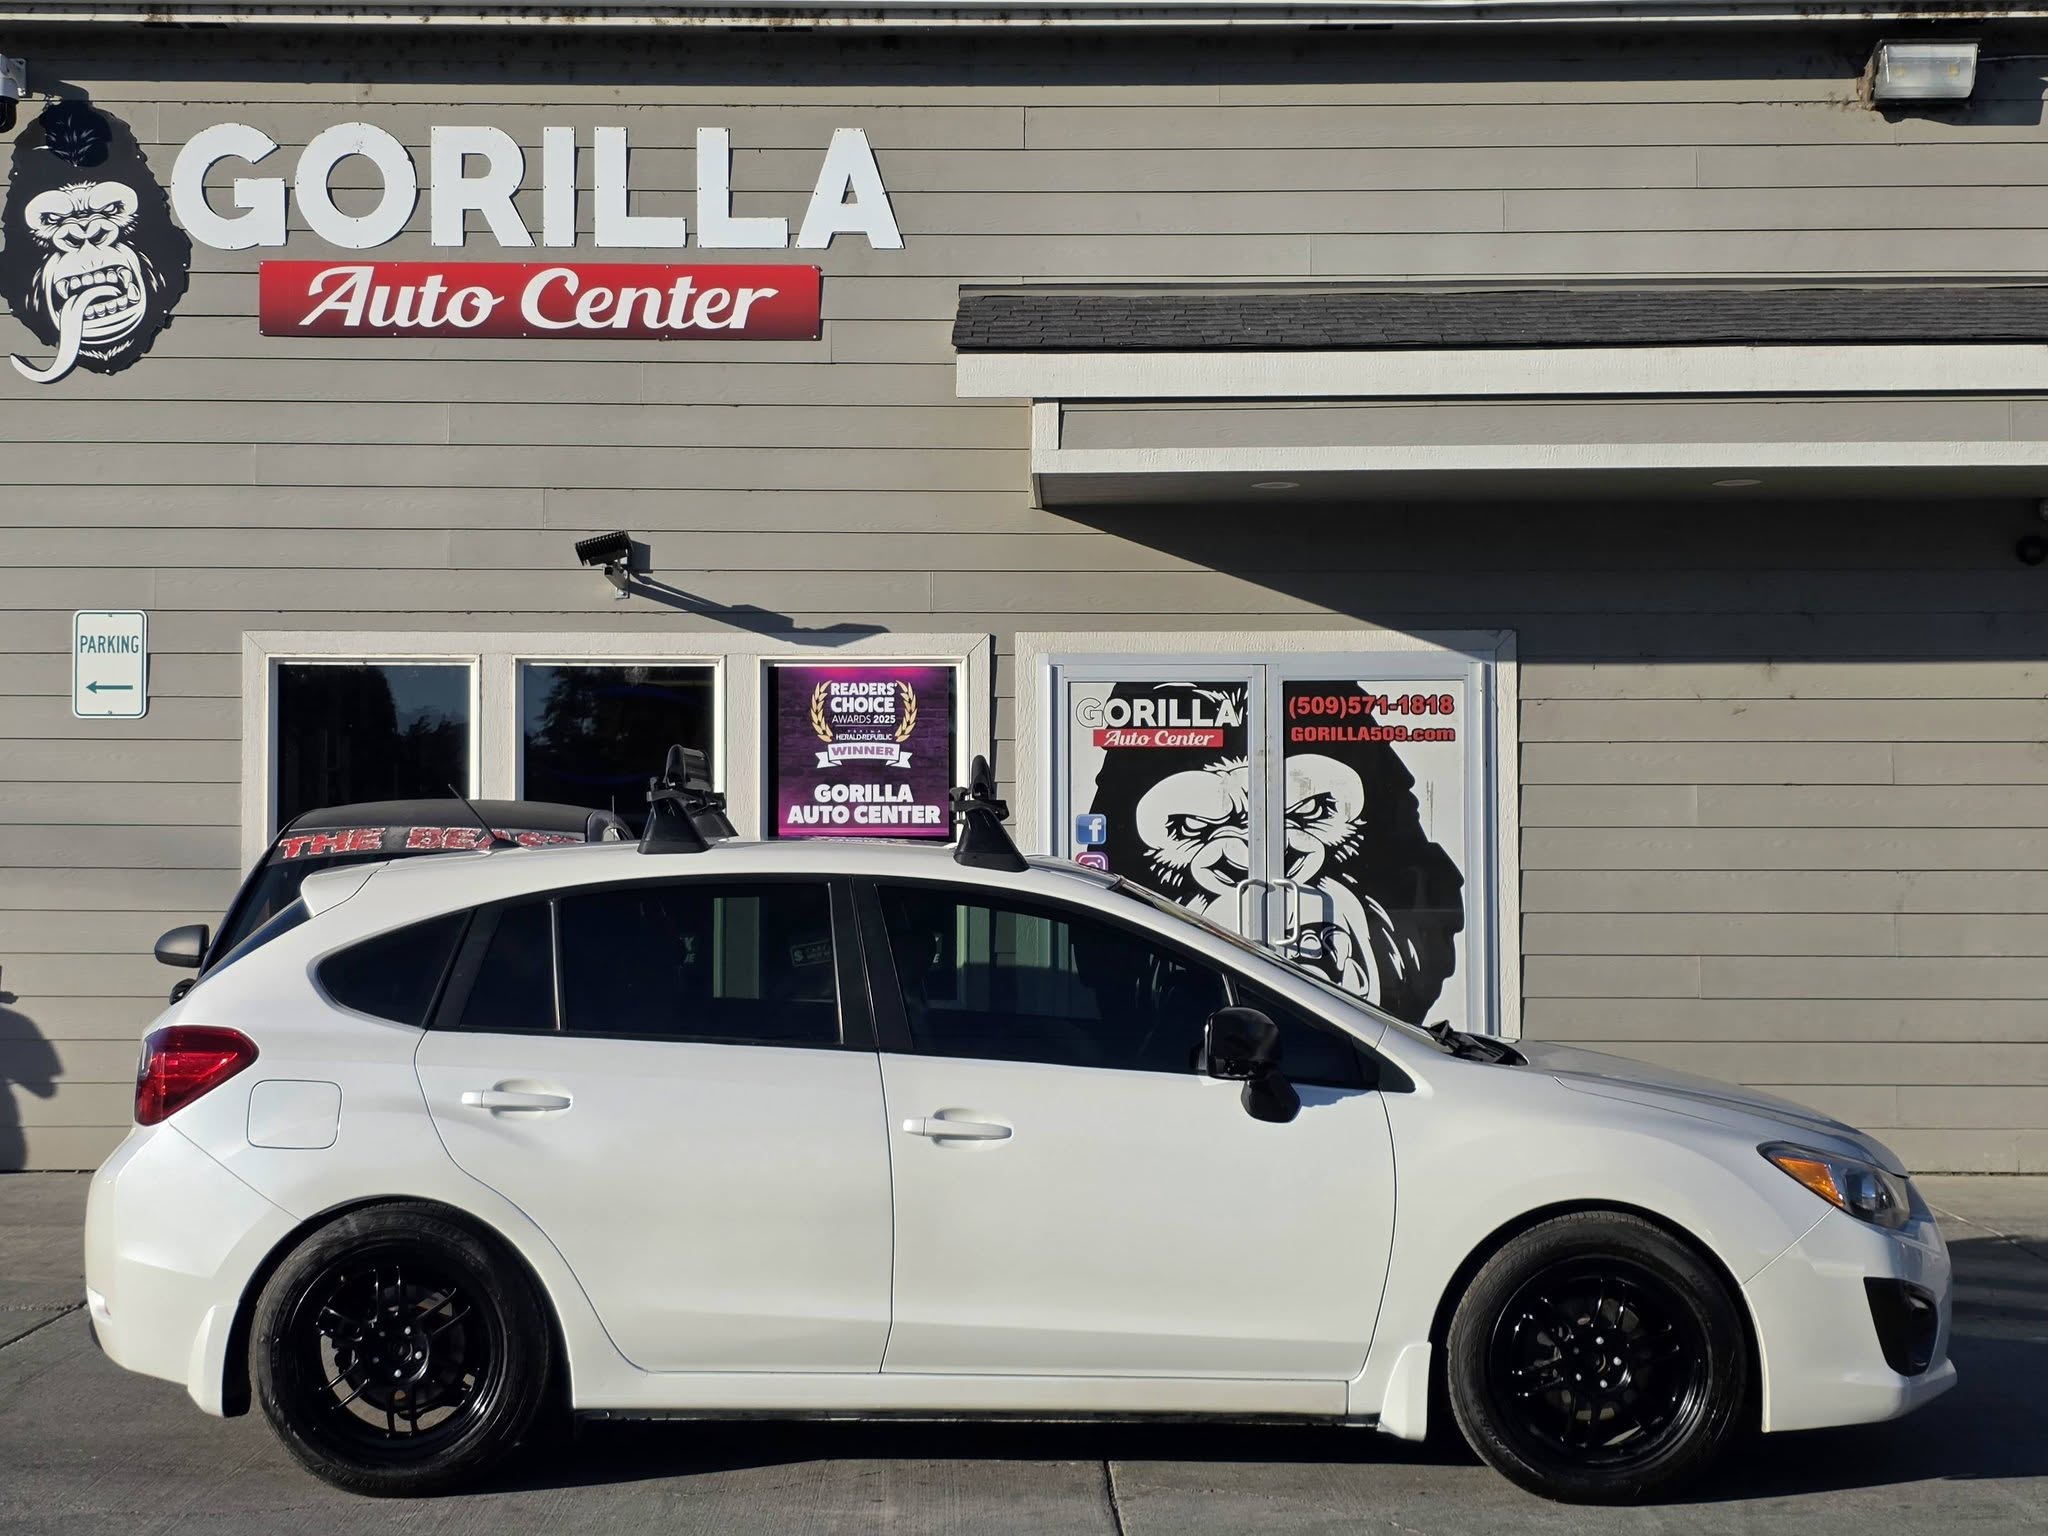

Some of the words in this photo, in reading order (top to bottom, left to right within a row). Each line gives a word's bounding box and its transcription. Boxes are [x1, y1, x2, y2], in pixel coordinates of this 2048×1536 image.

[170, 122, 904, 250] GORILLA
[298, 264, 506, 329] Auto
[520, 267, 780, 331] Center
[80, 635, 140, 653] PARKING
[830, 682, 897, 696] READERS'
[830, 696, 895, 713] CHOICE
[1076, 697, 1241, 728] GORILLA
[1289, 695, 1454, 718] (509)571-1818
[832, 714, 872, 724] AWARDS
[873, 714, 896, 724] 2025
[1104, 730, 1151, 746] Auto
[1153, 730, 1214, 746] Center
[1291, 725, 1455, 742] GORILLA509.com
[831, 746, 894, 756] WINNER
[814, 784, 914, 803] GORILLA
[787, 805, 850, 824] AUTO
[854, 805, 941, 824] CENTER
[278, 827, 386, 859] THE
